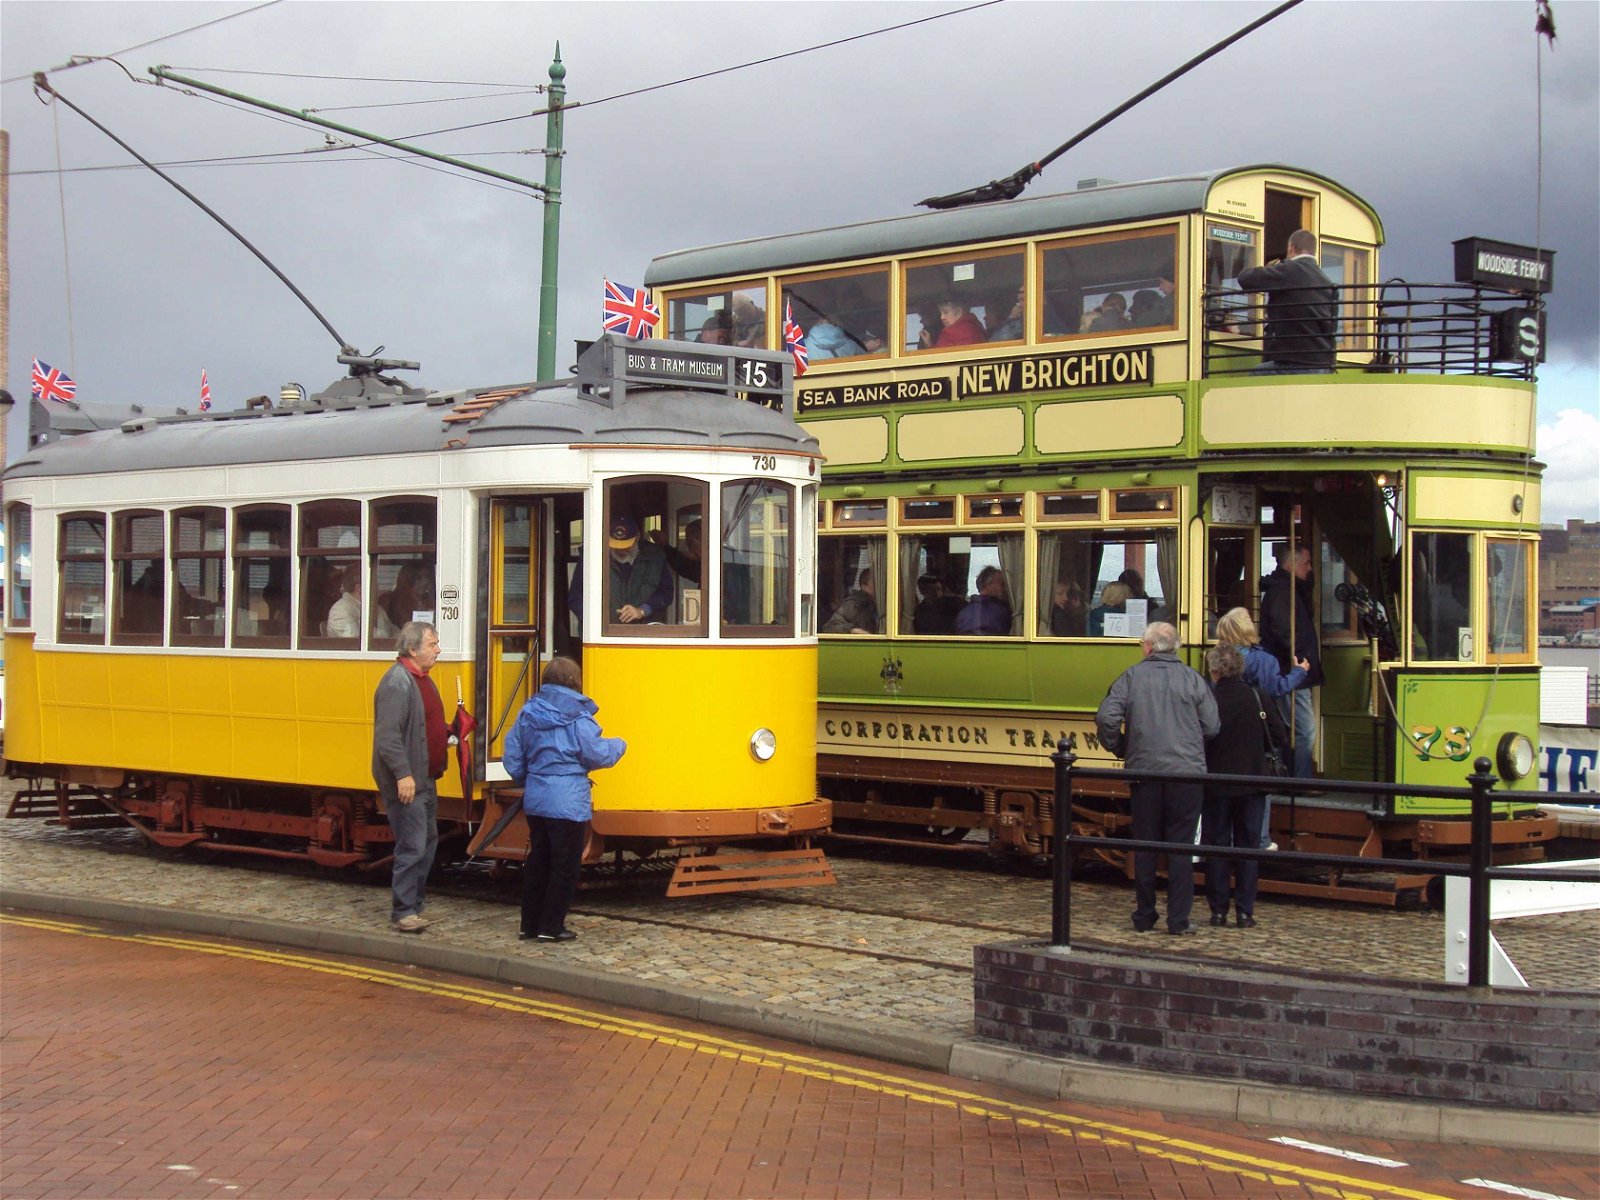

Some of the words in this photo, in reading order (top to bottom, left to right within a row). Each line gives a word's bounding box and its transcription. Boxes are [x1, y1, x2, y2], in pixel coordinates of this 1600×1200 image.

[1478, 251, 1518, 276] WOODSIDE
[1519, 260, 1546, 280] FERRY
[1519, 317, 1540, 357] S
[628, 354, 646, 369] BUS
[650, 356, 656, 370] &
[661, 357, 685, 373] TRAM
[689, 360, 723, 377] MUSEUM
[742, 360, 768, 388] 15
[962, 363, 1013, 395] NEW
[1021, 351, 1148, 391] BRIGHTON
[803, 390, 836, 406] SEA
[843, 386, 890, 404] BANK
[897, 381, 943, 399] ROAD
[752, 455, 776, 471] 730
[441, 606, 459, 621] 730
[685, 597, 700, 622] D
[1461, 633, 1472, 658] C
[825, 719, 988, 745] CORPORATION
[1412, 724, 1472, 762] 78
